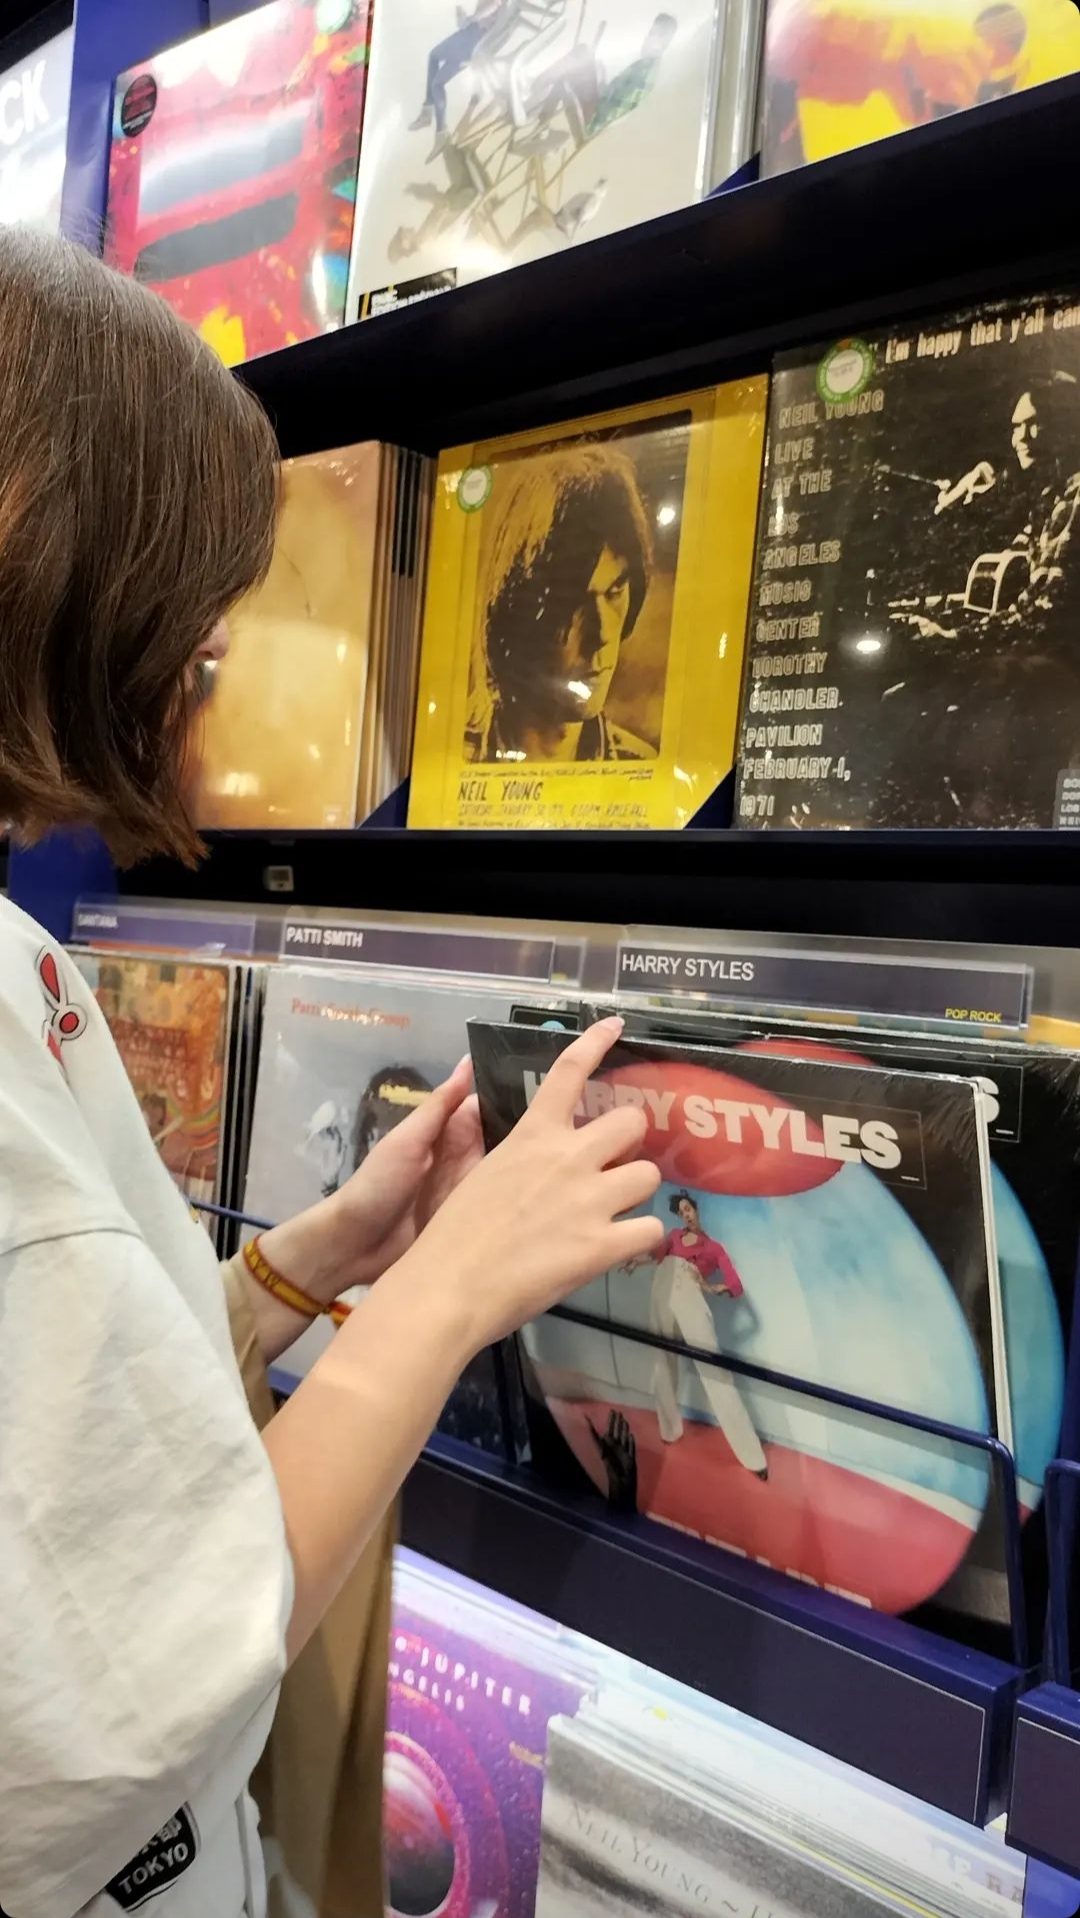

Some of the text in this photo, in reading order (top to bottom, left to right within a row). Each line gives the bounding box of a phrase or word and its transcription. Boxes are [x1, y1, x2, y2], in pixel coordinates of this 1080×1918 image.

[917, 332, 962, 358] happy
[970, 318, 1002, 347] that
[779, 402, 818, 430] NEIL
[774, 437, 814, 465] LIVE
[771, 469, 832, 500] AT THE
[762, 539, 841, 570] ANGELES
[758, 580, 812, 607] MUSIC
[756, 615, 820, 642] CENTER
[752, 652, 828, 679] DOROTHY
[745, 724, 823, 748] PAVILION
[458, 780, 543, 801] NEIL YOUNG
[740, 794, 775, 817] 1971
[286, 926, 364, 949] PATTI SMITH
[622, 953, 754, 981] HARRY STYLES
[945, 1008, 1002, 1023] POP ROCK
[683, 1095, 902, 1170] STYLES
[118, 1842, 189, 1895] TOKYO
